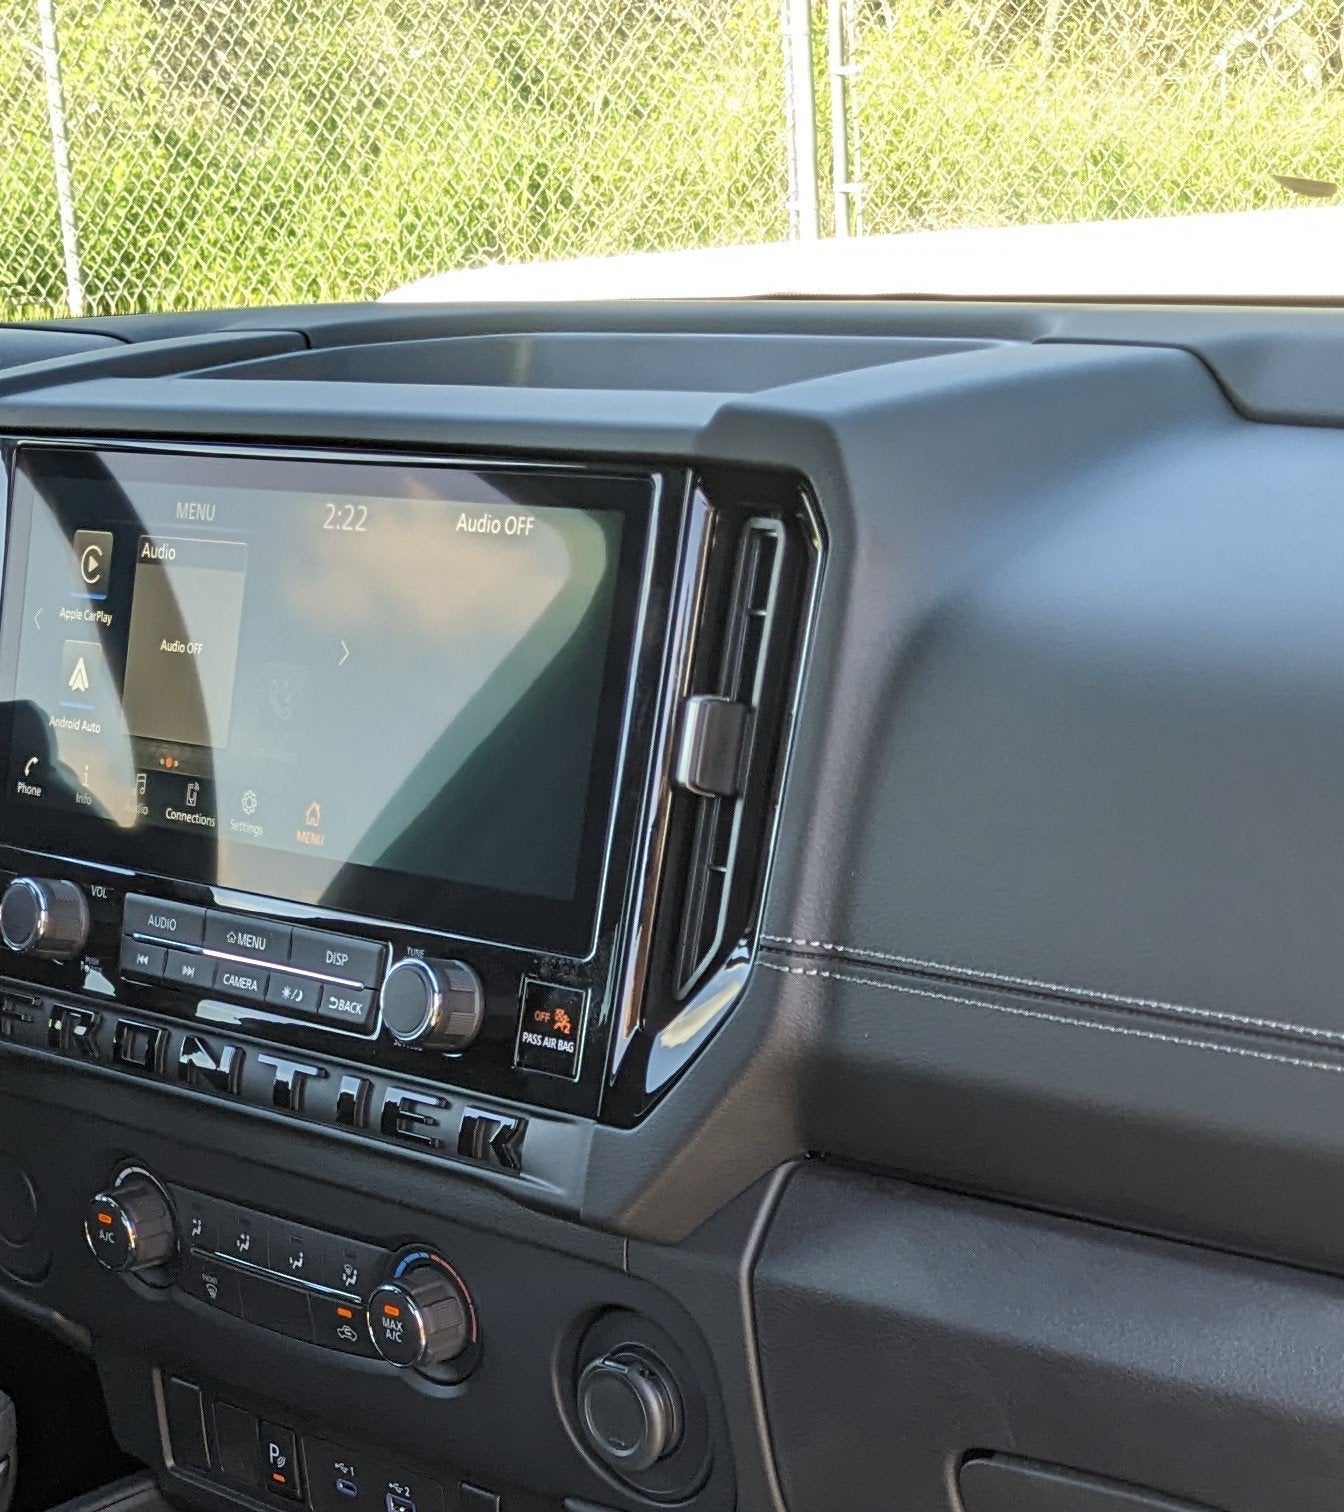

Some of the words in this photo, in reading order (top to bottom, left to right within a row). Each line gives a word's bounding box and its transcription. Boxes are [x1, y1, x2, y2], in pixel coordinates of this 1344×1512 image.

[176, 502, 216, 522] MENU
[323, 502, 369, 532] 2:22
[455, 512, 501, 534] Audio
[505, 515, 535, 535] OFF
[141, 542, 176, 561] Audio
[59, 607, 82, 622] Apple
[83, 609, 113, 626] CarPlay
[160, 639, 186, 653] Audio
[187, 643, 203, 655] OFF
[49, 715, 80, 732] Android
[82, 719, 101, 733] Auto
[17, 781, 42, 797] Phone
[165, 807, 215, 827] Connections
[230, 818, 263, 837] Settings
[296, 829, 325, 846] MENU
[91, 885, 107, 899] VOL
[147, 914, 177, 931] AUDIO
[237, 932, 267, 951] MENU
[326, 950, 349, 967] DISP
[223, 973, 258, 991] CAMERA
[338, 998, 363, 1015] BACK
[533, 1010, 551, 1023] OFF
[522, 1031, 542, 1047] PASS
[543, 1036, 557, 1049] AIR
[557, 1039, 575, 1053] BAG
[98, 1229, 115, 1244] A/C
[382, 1316, 404, 1333] MAX
[385, 1330, 403, 1343] A/C
